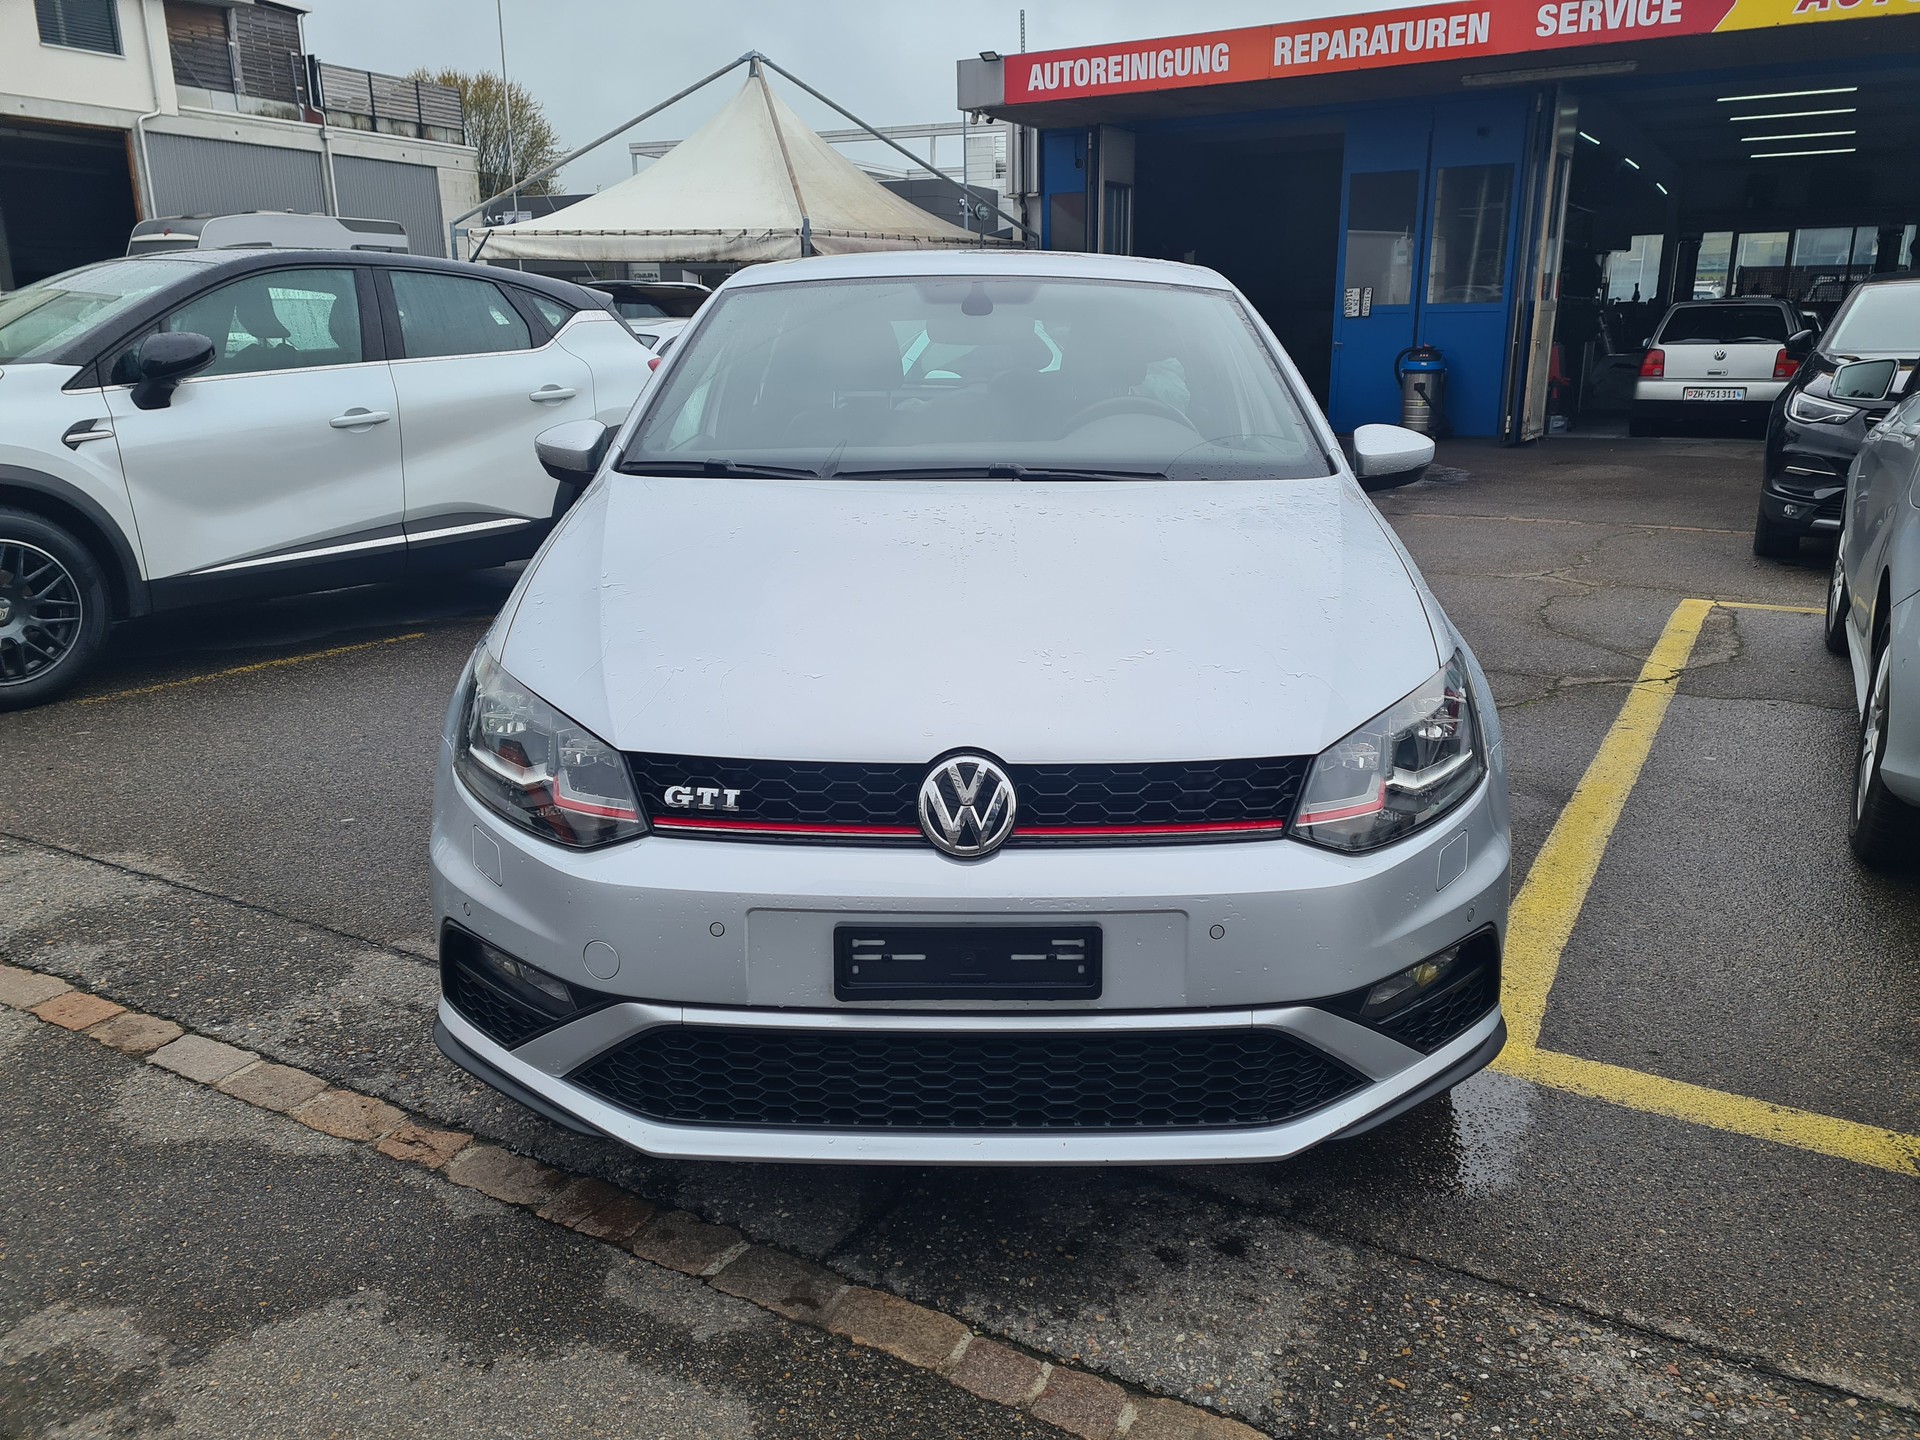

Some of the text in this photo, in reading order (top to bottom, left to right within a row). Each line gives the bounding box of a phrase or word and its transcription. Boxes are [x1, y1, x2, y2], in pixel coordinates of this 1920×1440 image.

[1027, 0, 1683, 92] AUTOREINIGUNG REPARATUREN SERVICE
[664, 785, 741, 811] GTI
